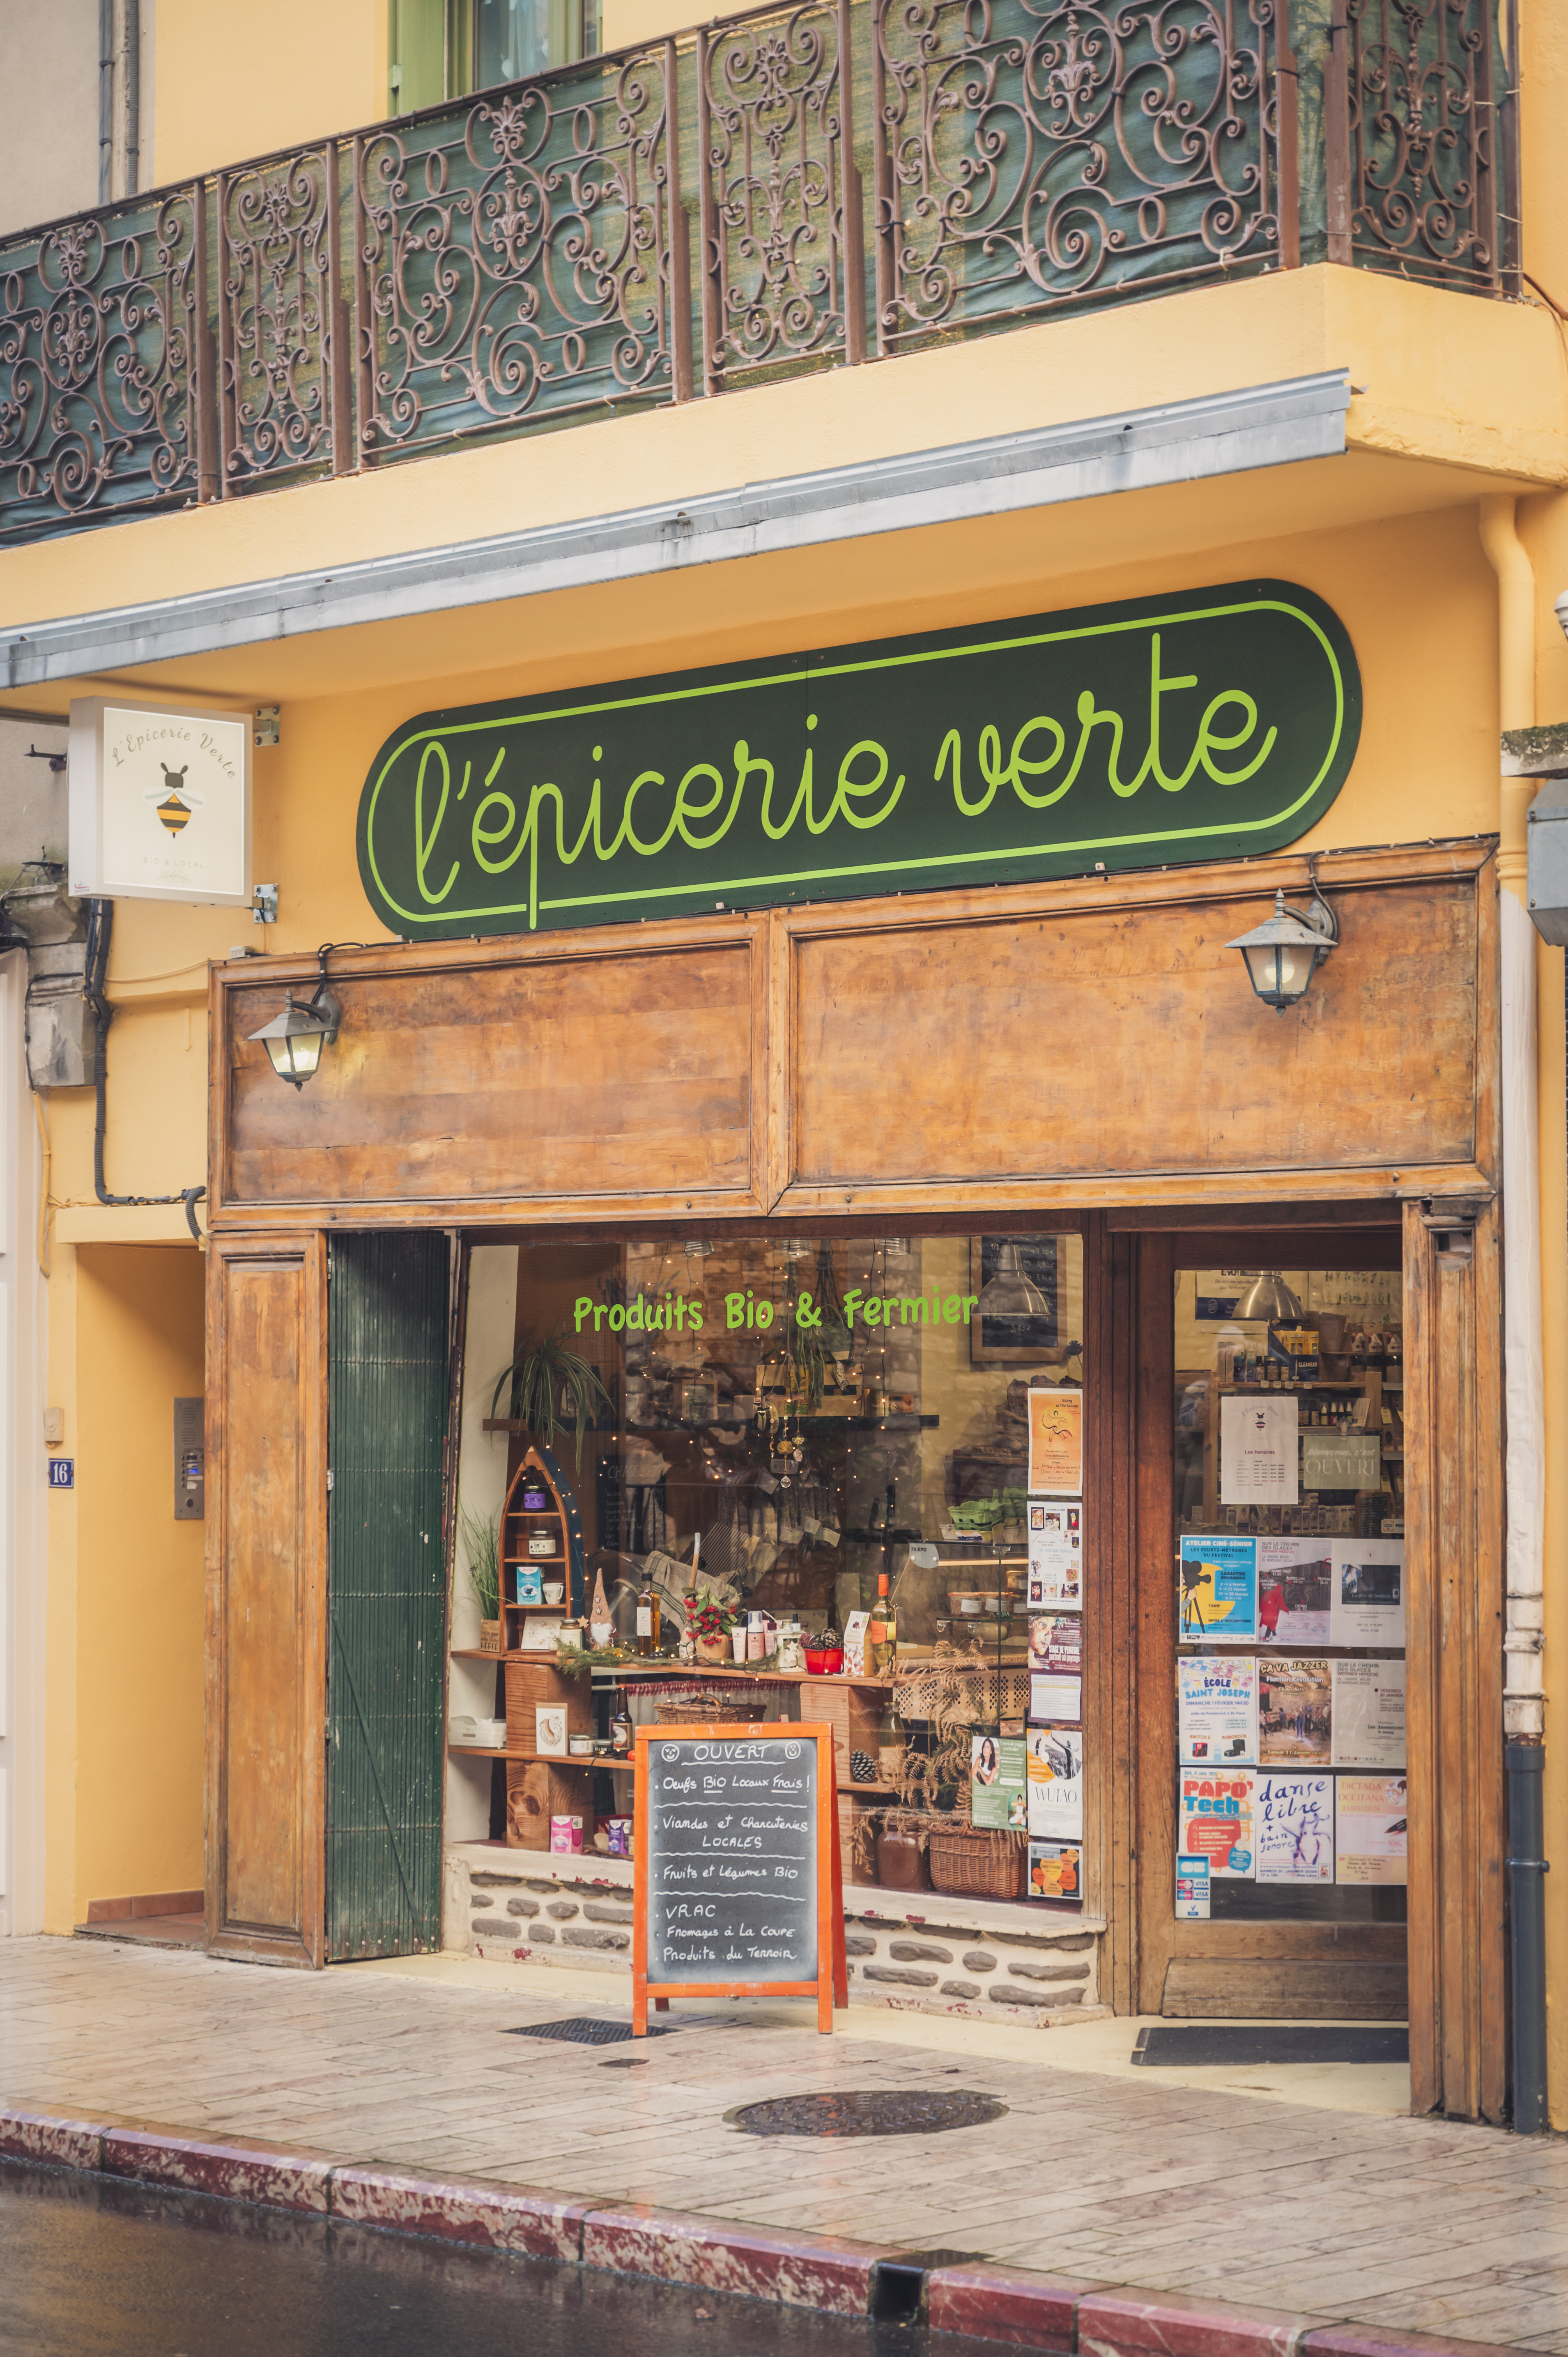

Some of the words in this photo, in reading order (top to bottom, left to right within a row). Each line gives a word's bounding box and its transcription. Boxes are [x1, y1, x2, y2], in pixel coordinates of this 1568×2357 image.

[112, 727, 191, 767] L'Epicerie
[200, 732, 235, 779] Verte
[415, 713, 906, 929] l'épicerie
[934, 632, 1278, 818] verte
[175, 860, 204, 868] LOCAL
[573, 1293, 703, 1333] Produits
[724, 1289, 774, 1330] Bio
[795, 1291, 822, 1328] &
[843, 1286, 979, 1328] Fermier
[53, 1463, 68, 1483] 16
[1305, 1459, 1377, 1477] OUVERT
[1261, 1664, 1274, 1673] ÇA
[1275, 1663, 1289, 1672] VA
[1204, 1676, 1232, 1688] ÉCOLE
[1185, 1689, 1213, 1699] SAINT
[1217, 1689, 1251, 1699] JOSEPH
[694, 1743, 772, 1761] OUVERT
[663, 1776, 697, 1793] Oeufs
[731, 1775, 769, 1787] Locaux
[773, 1773, 802, 1788] Frais
[1184, 1780, 1253, 1798] PAPO'
[1260, 1780, 1329, 1802] danse
[1342, 1782, 1381, 1790] DICTADA
[1035, 1787, 1077, 1804] WUTAO
[1338, 1793, 1384, 1802] OCCITANA
[1183, 1796, 1239, 1814] Tech
[1262, 1797, 1323, 1823] libre
[663, 1815, 708, 1830] Viandes
[718, 1814, 733, 1829] et
[702, 1836, 763, 1850] LOCALES
[1260, 1832, 1288, 1843] bain
[663, 1866, 698, 1881] Fruits
[703, 1865, 715, 1878] et
[719, 1866, 767, 1881] Légumes
[1181, 1862, 1206, 1873] CB
[666, 1904, 716, 1918] VRAC
[667, 1924, 719, 1938] Fromages
[724, 1924, 734, 1937] à
[663, 1944, 715, 1961] Produits
[727, 1945, 743, 1960] du
